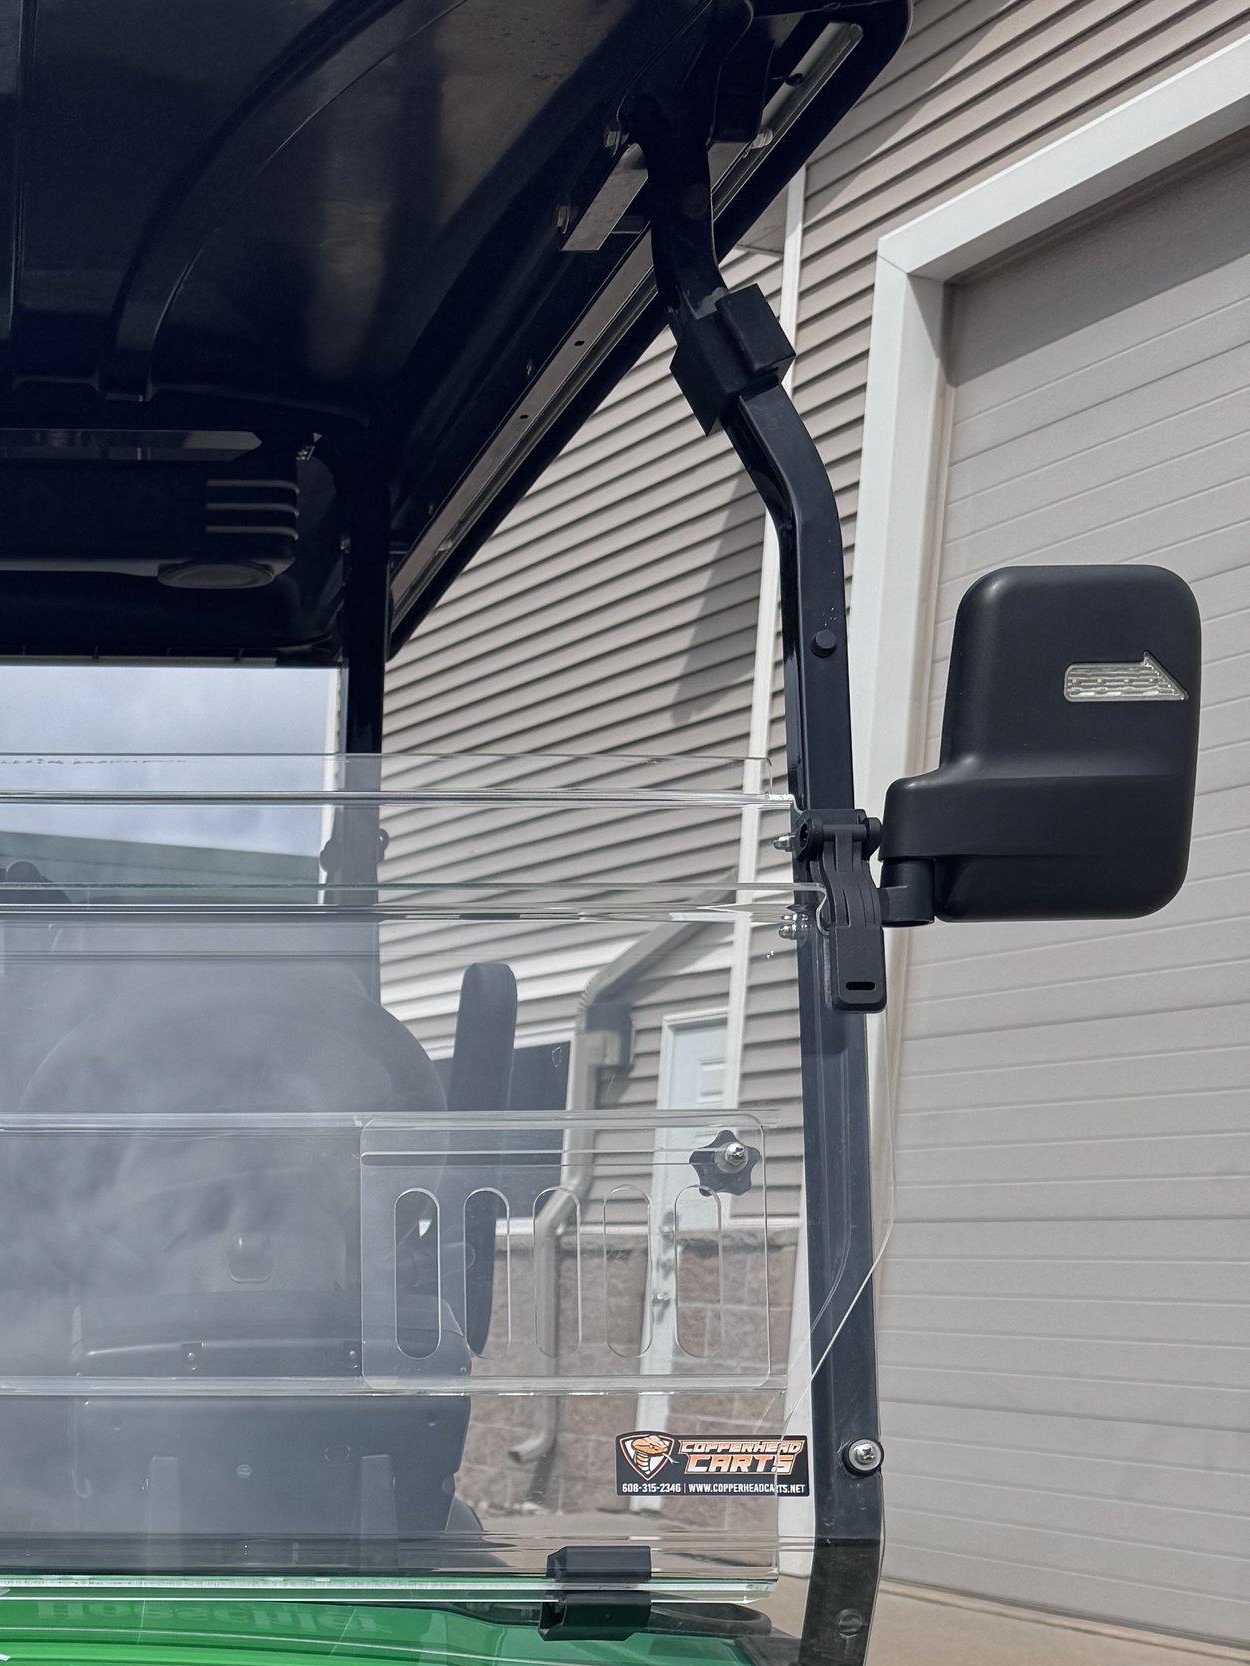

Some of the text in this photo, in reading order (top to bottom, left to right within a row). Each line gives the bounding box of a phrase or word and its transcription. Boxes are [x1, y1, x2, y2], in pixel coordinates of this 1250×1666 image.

[680, 1441, 804, 1454] COPPERHEAD
[686, 1454, 796, 1474] CARTS
[622, 1483, 681, 1493] 608-315-2346
